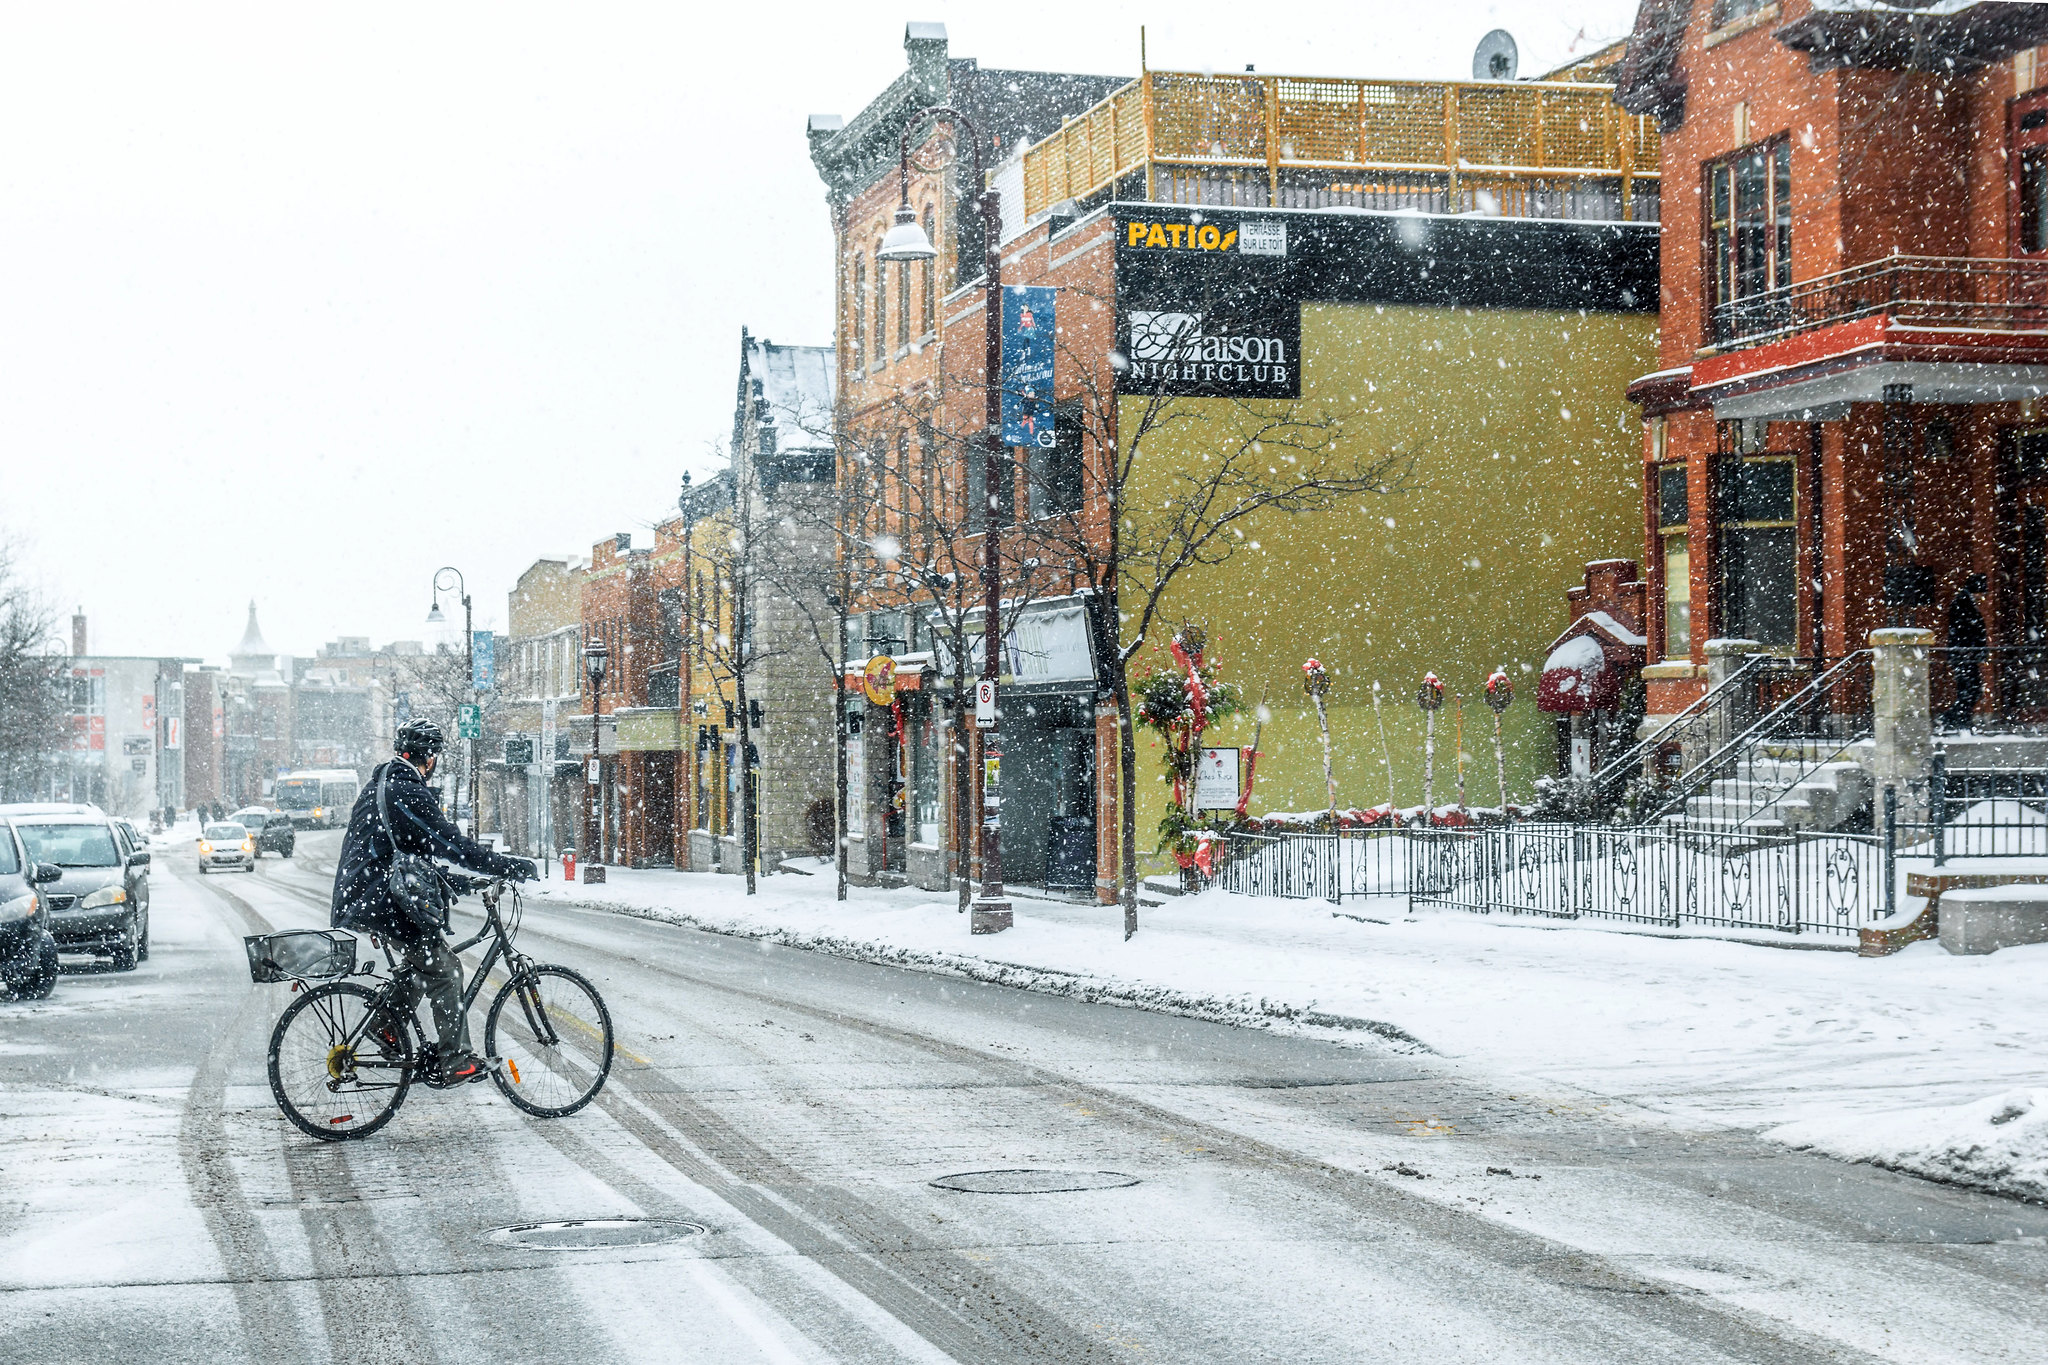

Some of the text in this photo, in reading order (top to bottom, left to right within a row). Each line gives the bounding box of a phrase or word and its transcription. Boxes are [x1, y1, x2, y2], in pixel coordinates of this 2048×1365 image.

[1128, 222, 1221, 250] PATIO
[1245, 224, 1281, 236] TERRASSE
[1243, 238, 1257, 250] SUR
[1258, 239, 1267, 250] LE
[1131, 311, 1287, 363] Maison
[1131, 361, 1287, 382] NIGHTCLUB
[473, 970, 486, 988] OPUS
